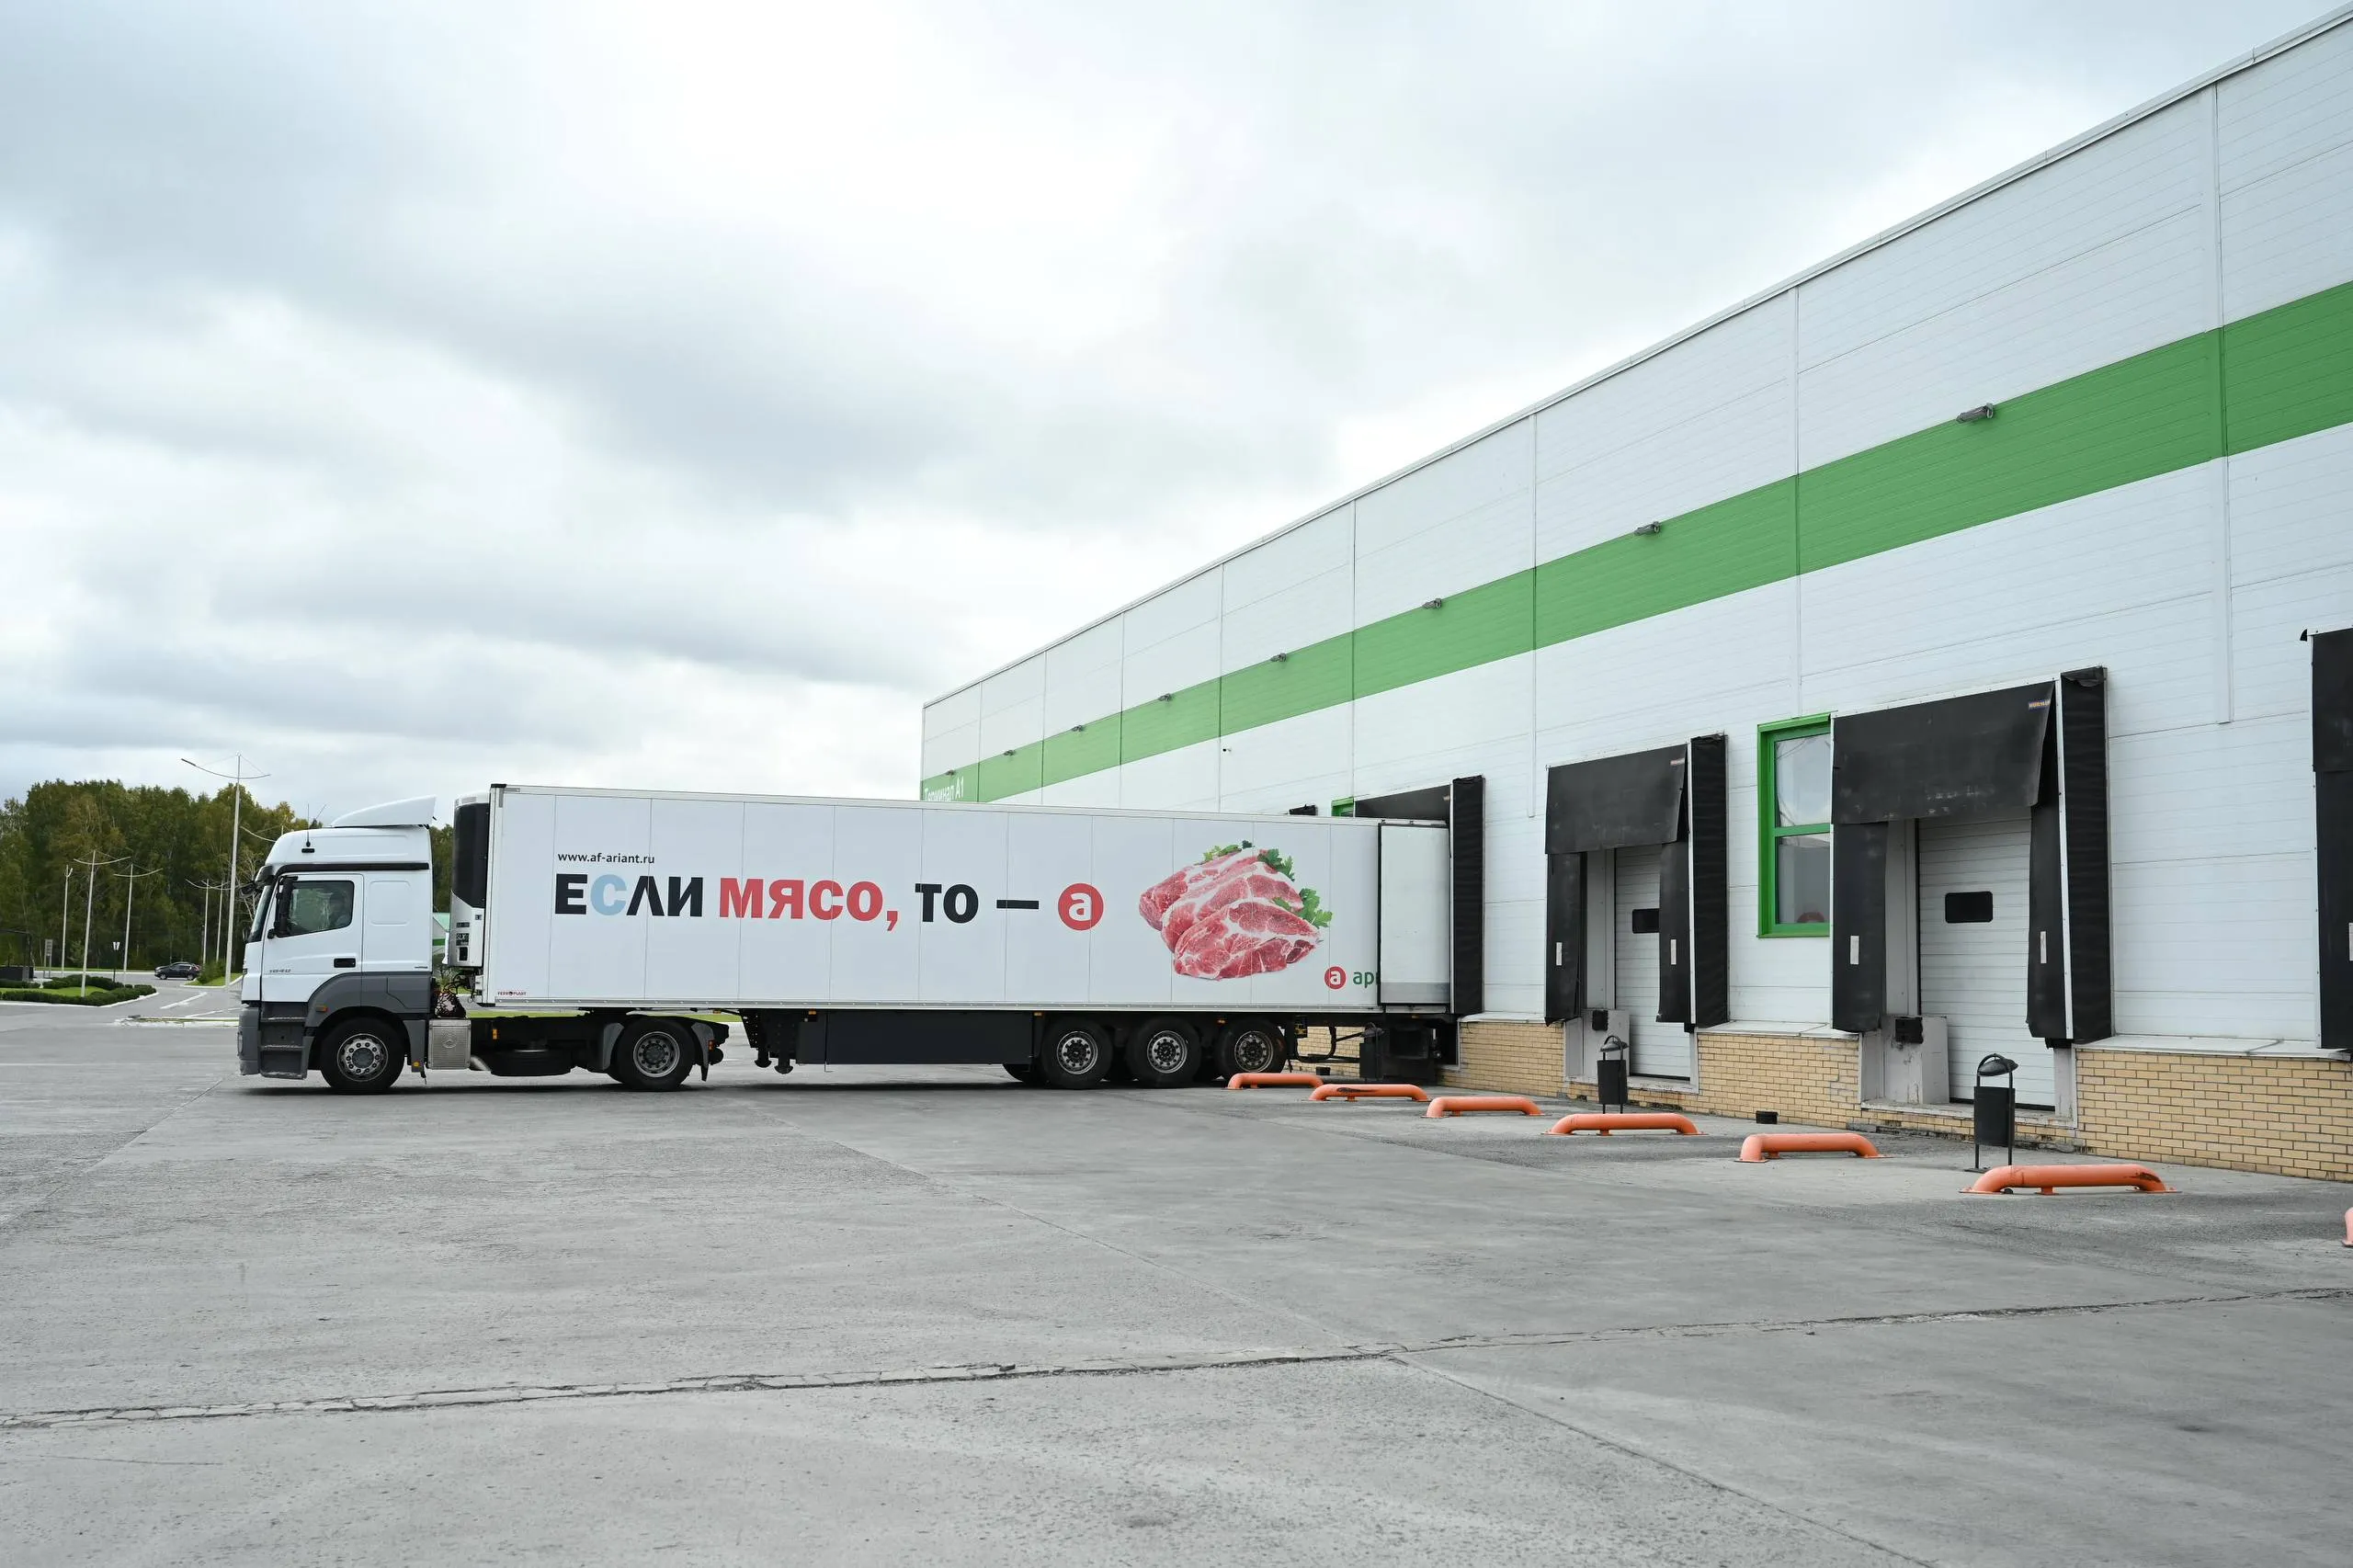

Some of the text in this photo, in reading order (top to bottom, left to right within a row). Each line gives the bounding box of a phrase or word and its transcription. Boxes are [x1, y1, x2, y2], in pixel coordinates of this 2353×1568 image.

[558, 853, 655, 864] www.af-ariant.ru
[555, 873, 703, 917] ЕСЛИ
[720, 878, 898, 931] МЯСО,
[915, 883, 979, 924] ТО
